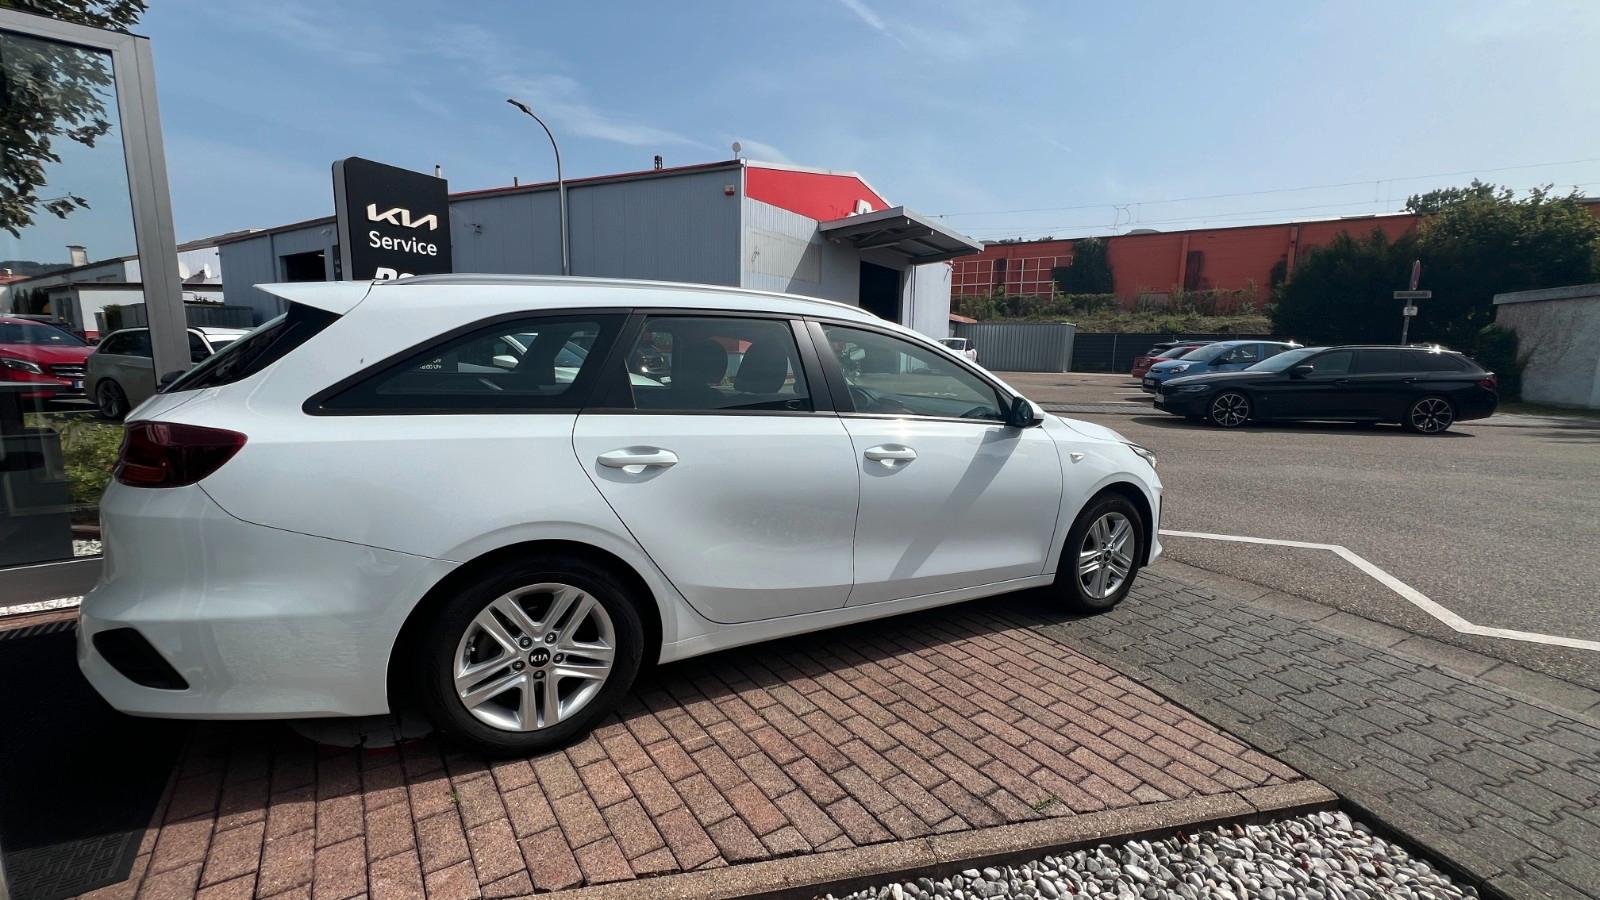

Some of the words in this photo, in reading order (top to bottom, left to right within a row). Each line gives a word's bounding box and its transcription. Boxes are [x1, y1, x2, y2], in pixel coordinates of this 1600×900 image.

[367, 203, 438, 231] KIA
[369, 230, 438, 256] Service
[530, 654, 549, 663] KIA
